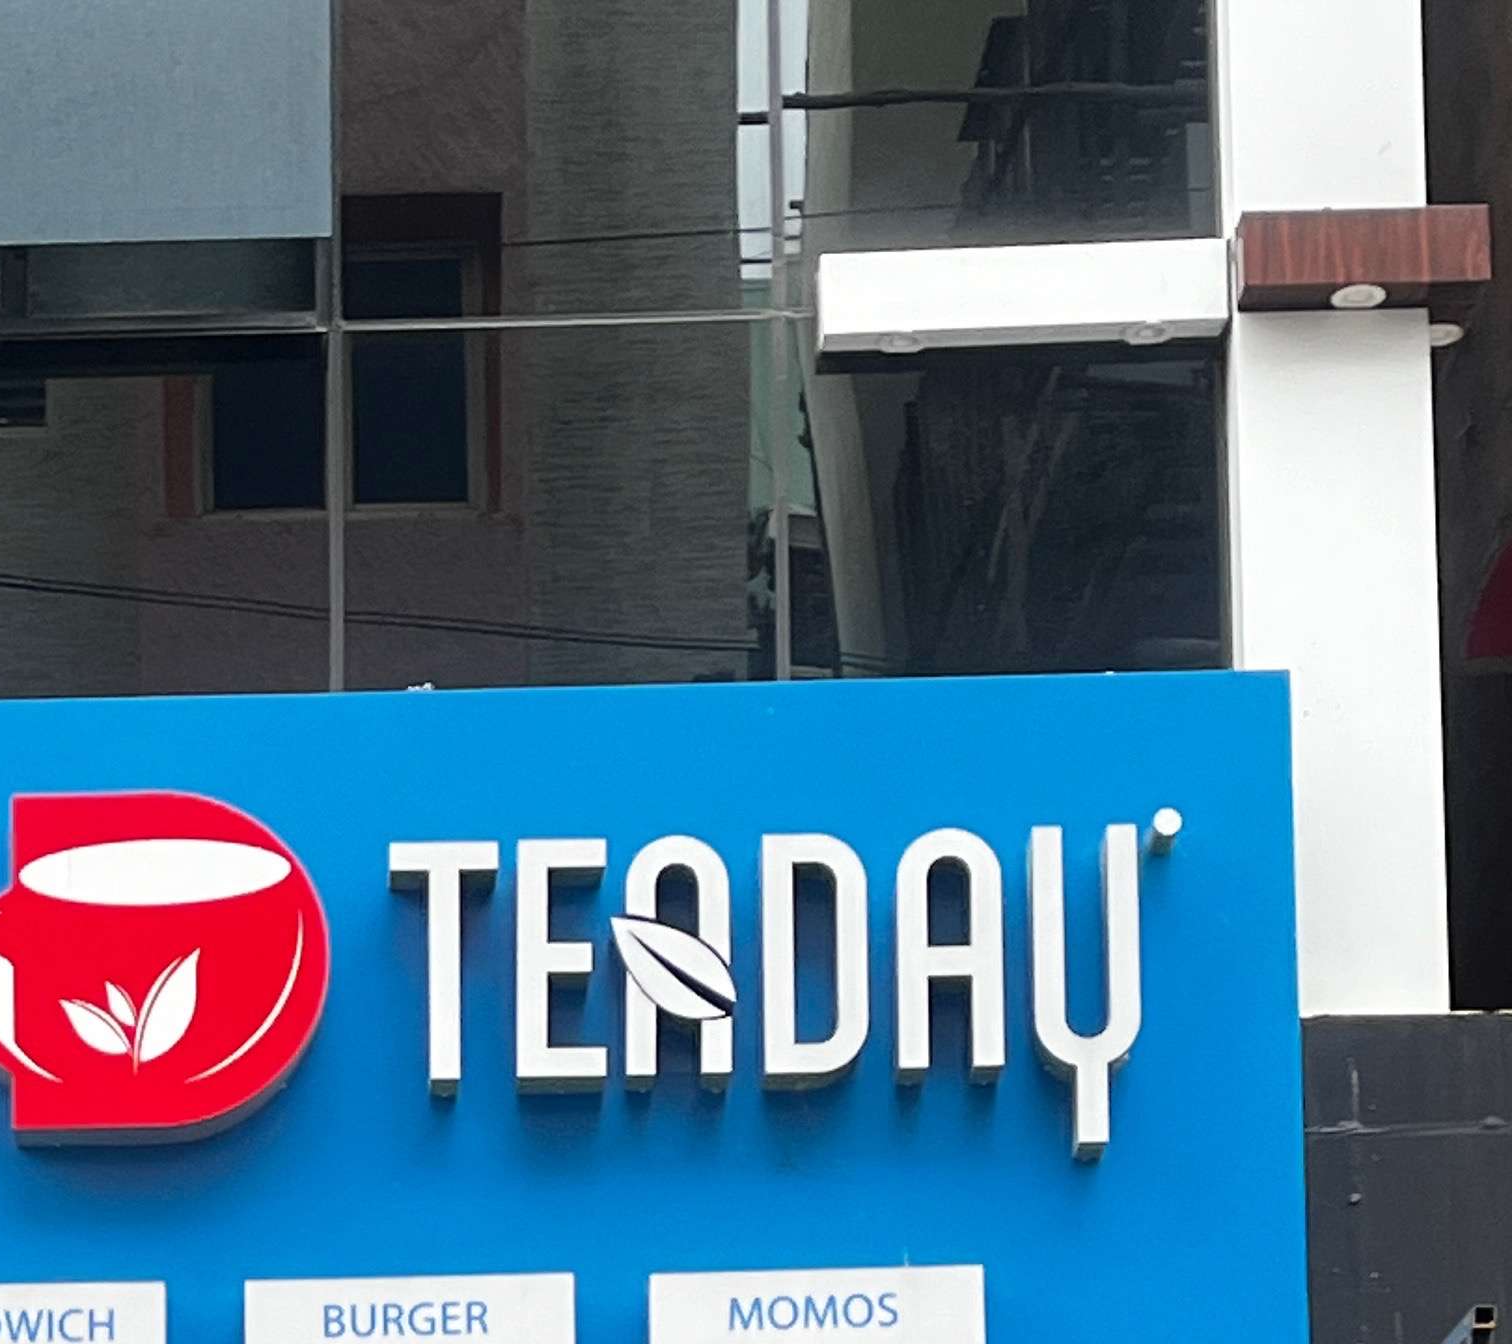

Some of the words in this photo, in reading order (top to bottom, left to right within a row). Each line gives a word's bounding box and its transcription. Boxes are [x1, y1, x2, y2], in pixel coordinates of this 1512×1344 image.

[387, 820, 1148, 1160] TEADAY
[321, 1301, 491, 1340] BURGER
[727, 1292, 901, 1331] MOMOS
